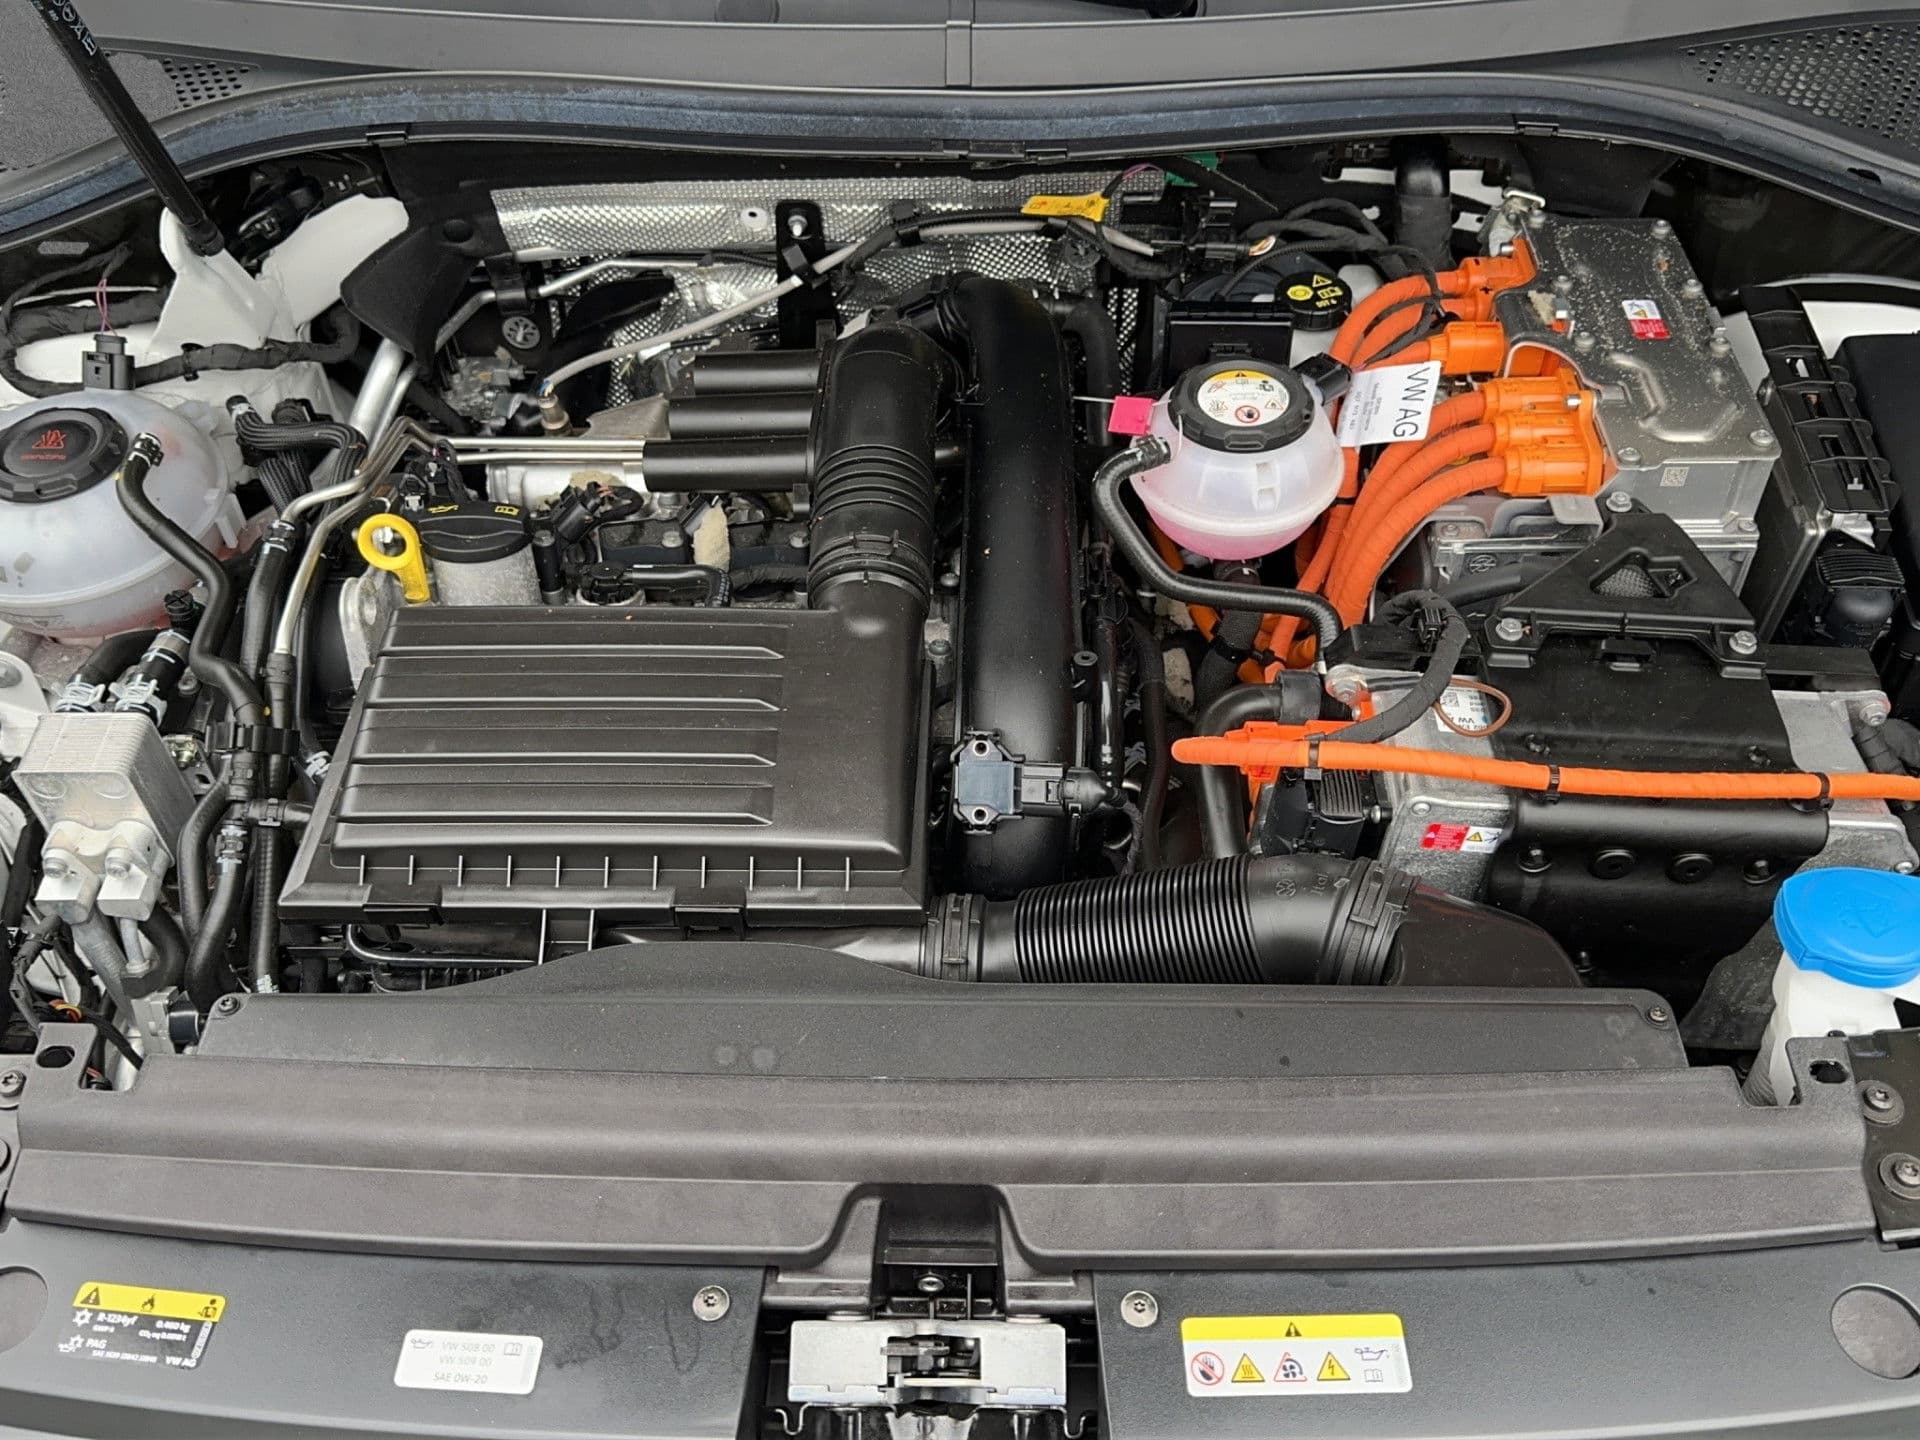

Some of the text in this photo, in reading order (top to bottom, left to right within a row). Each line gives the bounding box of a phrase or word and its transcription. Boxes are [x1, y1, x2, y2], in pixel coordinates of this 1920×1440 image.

[1393, 367, 1431, 437] VW AG
[86, 1338, 107, 1349] PAG
[442, 1341, 496, 1352] VW 508 00
[165, 1356, 182, 1366] VW
[182, 1358, 198, 1368] AG
[439, 1355, 455, 1364] VW
[479, 1356, 492, 1366] 00
[433, 1371, 489, 1384] SAE 0W-20
